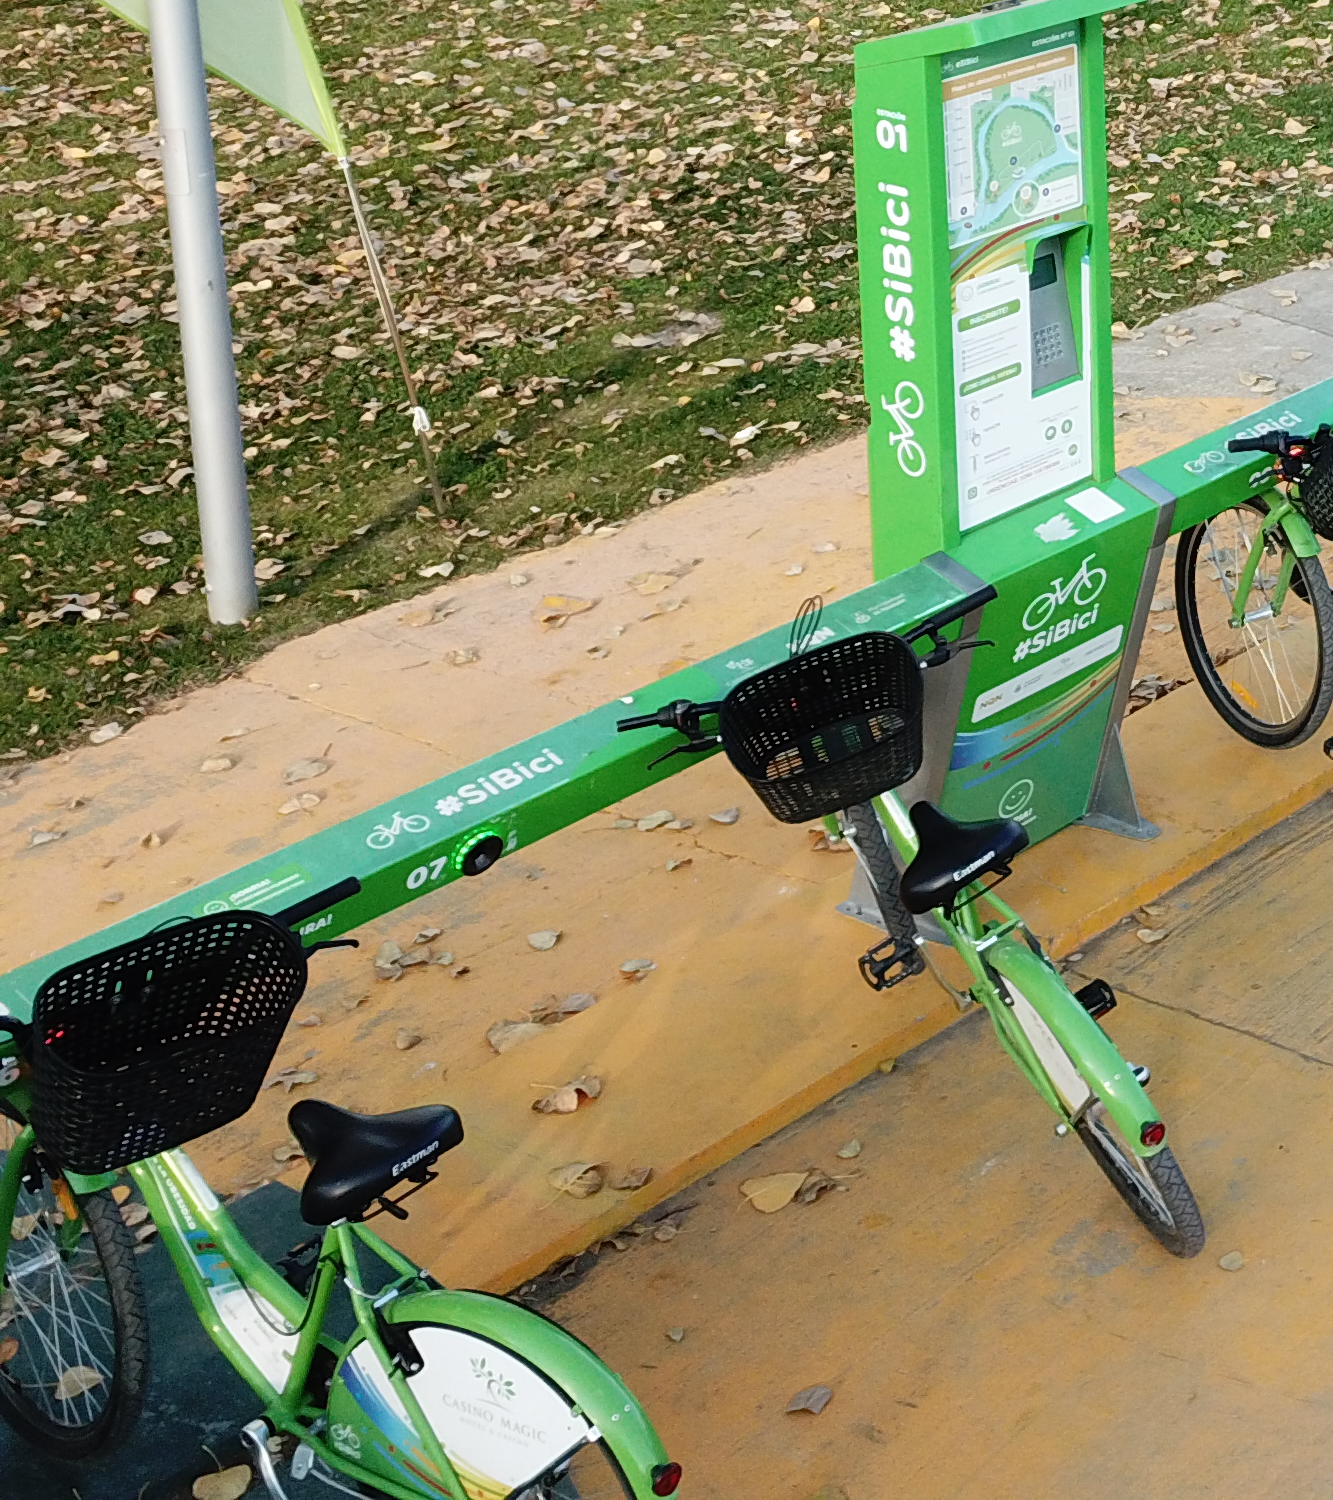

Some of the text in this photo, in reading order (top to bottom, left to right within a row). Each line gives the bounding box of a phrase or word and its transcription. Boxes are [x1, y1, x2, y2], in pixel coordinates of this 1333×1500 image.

[876, 119, 908, 153] 01
[878, 181, 916, 362] #SiBici
[1012, 603, 1100, 663] #SiBici
[434, 748, 564, 816] #SiBici
[406, 856, 447, 890] 07
[953, 850, 996, 882] Eastman
[392, 1141, 439, 1177] Eastman
[442, 1393, 547, 1444] CASINO MAGIC
